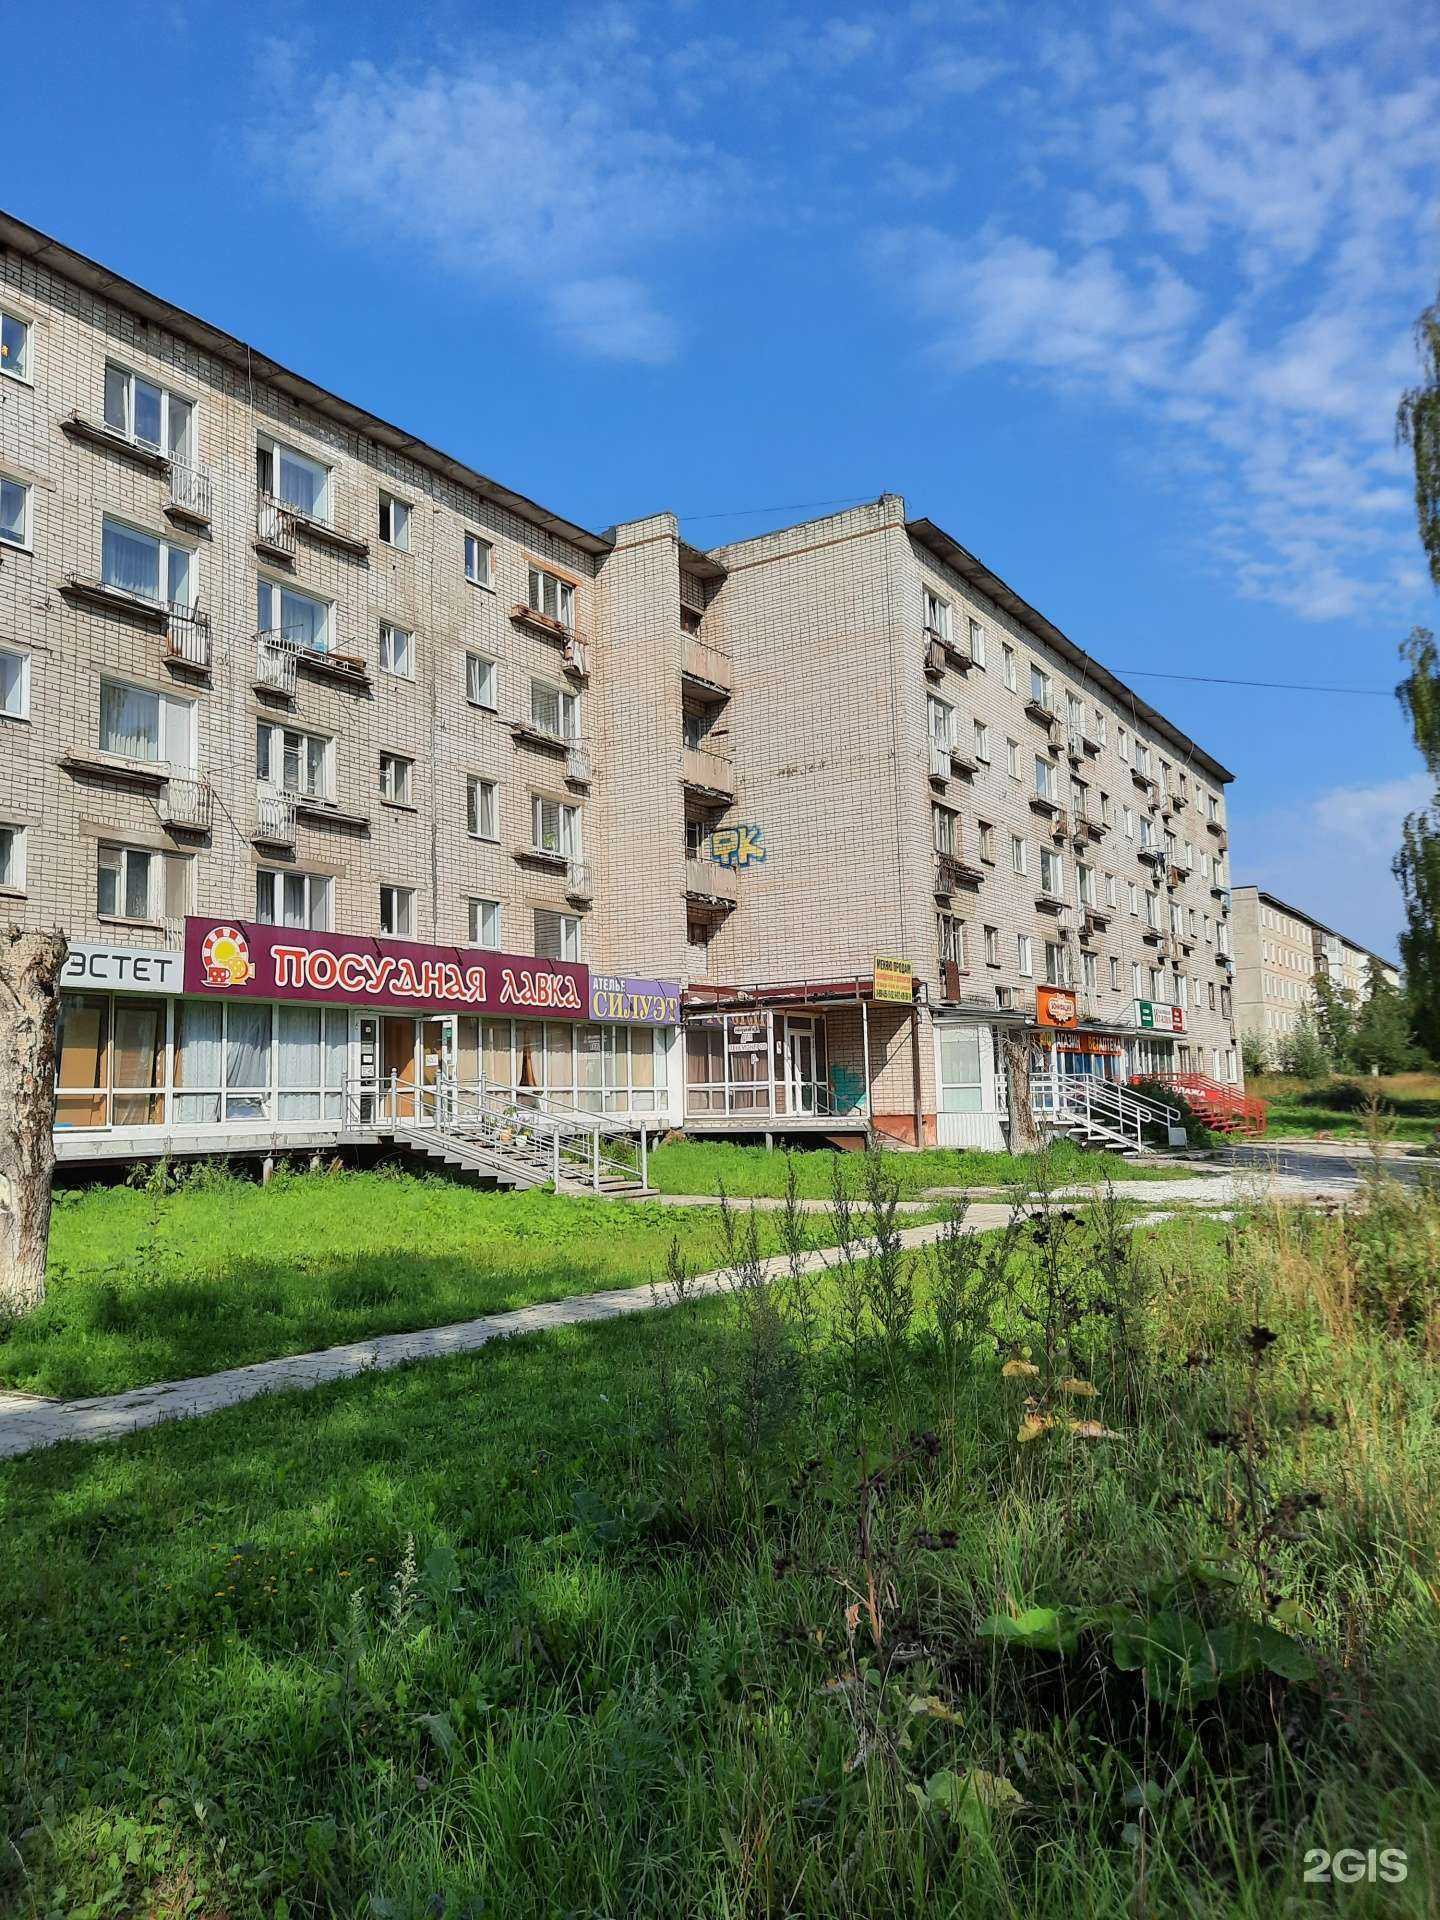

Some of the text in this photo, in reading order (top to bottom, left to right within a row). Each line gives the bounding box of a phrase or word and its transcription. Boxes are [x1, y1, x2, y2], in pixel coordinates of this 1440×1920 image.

[66, 951, 173, 982] ЭСТЕТ
[271, 945, 581, 1008] ПОСУДНАЯ ЛАВКА
[593, 977, 625, 992] АТЕЛЬЕ
[593, 991, 677, 1021] СИЛУЭТ
